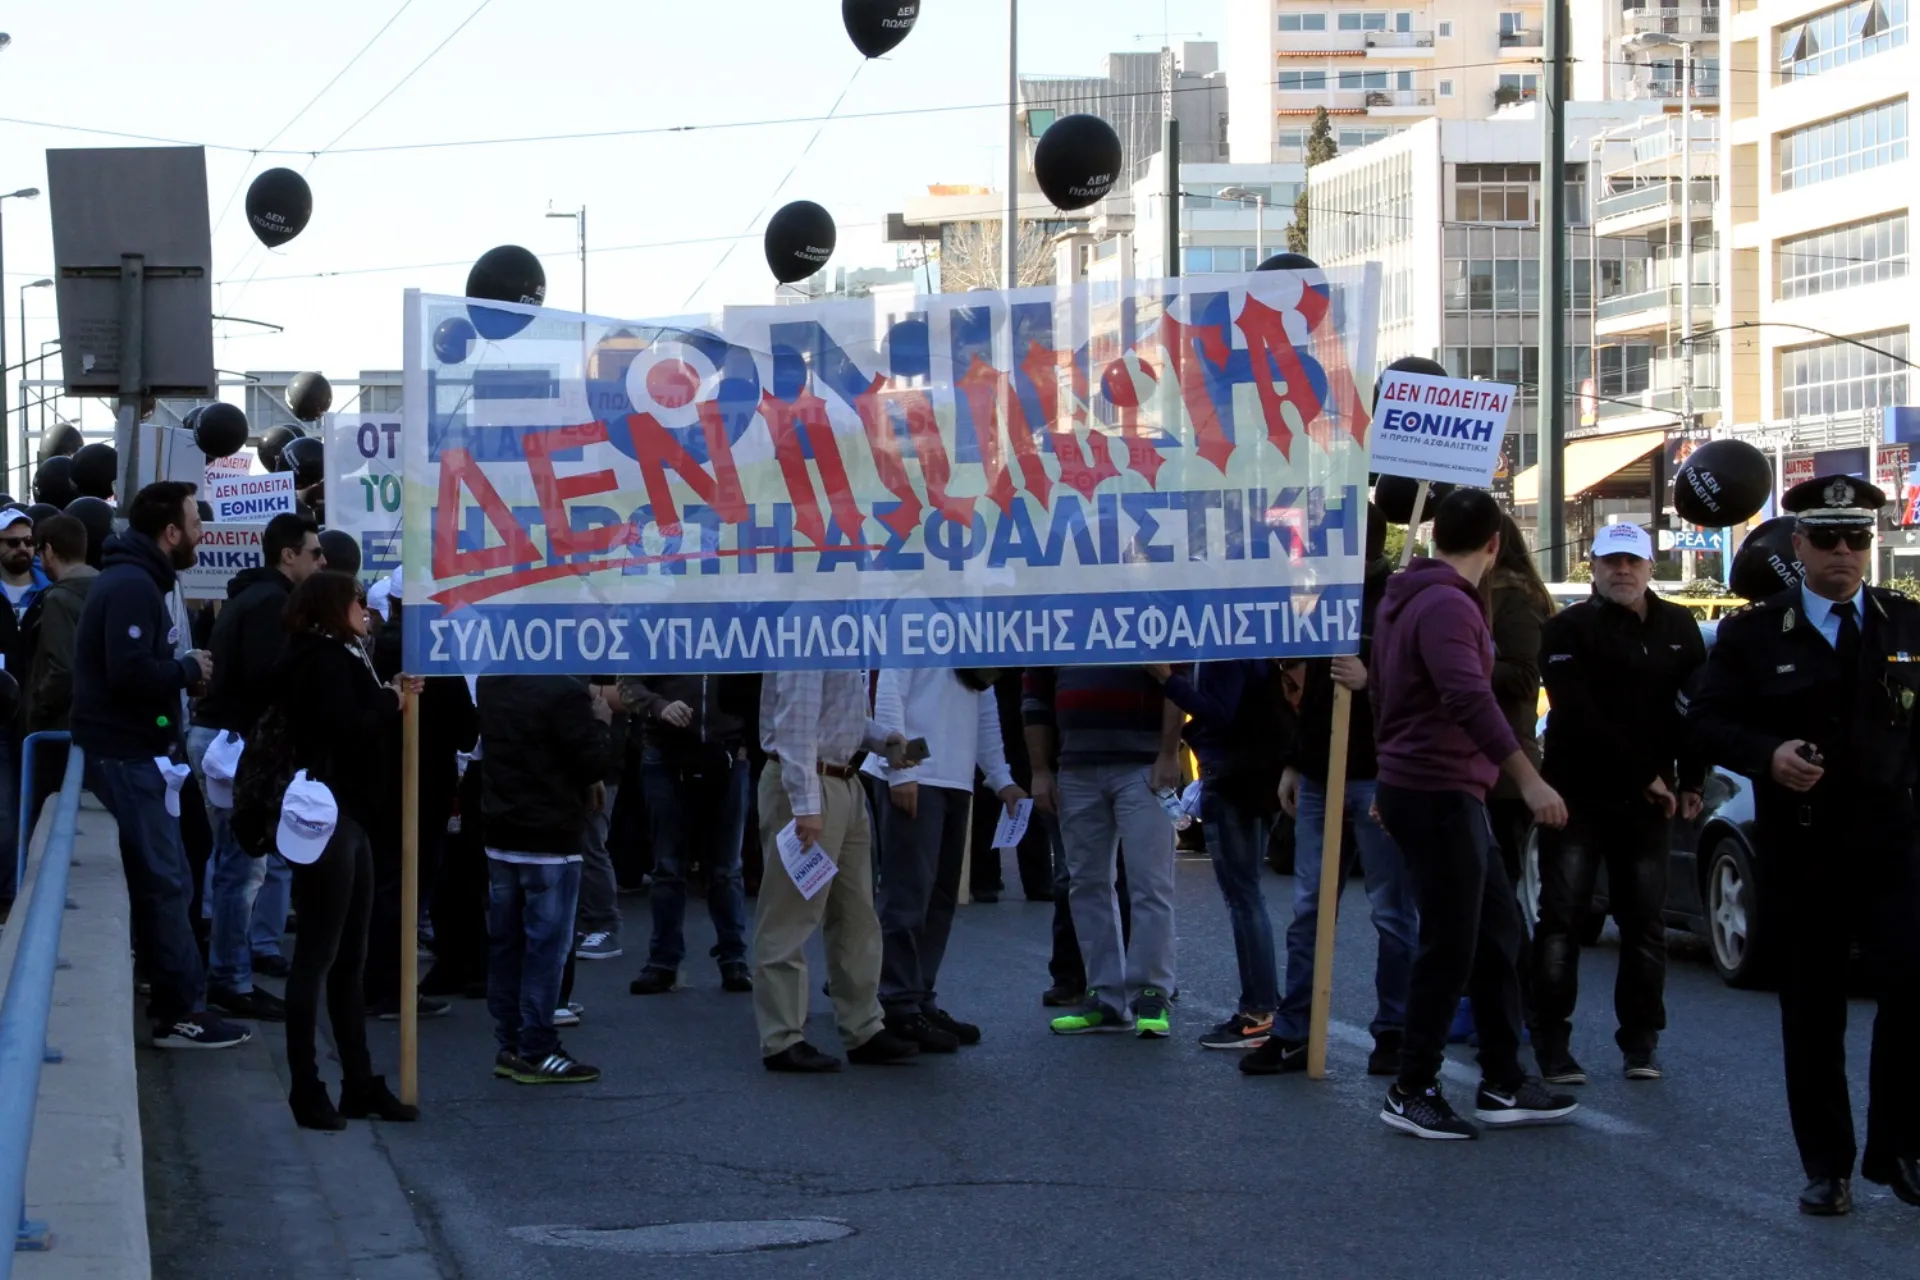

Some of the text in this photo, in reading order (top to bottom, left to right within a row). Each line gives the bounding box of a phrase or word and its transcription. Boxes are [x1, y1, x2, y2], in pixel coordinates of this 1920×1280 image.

[1087, 173, 1111, 186] ΔΕΝ
[265, 212, 286, 223] ΔΕΝ
[1384, 381, 1508, 413] ΔΕΝ ΠΩΛΕΙΤΑΙ
[1383, 408, 1494, 442] ΕΘΝΙΚΗ
[1389, 434, 1422, 445] ΠΡΩΤΗ
[1424, 437, 1489, 453] ΑΣΦΑΛΙΣΤΙΚΗ
[216, 485, 239, 499] ΔΕΝ
[241, 478, 292, 495] ΠΩΛΕΙΤΑΙ
[432, 399, 751, 581] ΔΕΝ
[1686, 466, 1721, 514] ΠΩΛΕΙΤΑΙ
[1700, 471, 1722, 495] ΔΕΝ
[220, 496, 289, 517] ΕΘΝΙΚΗ
[200, 531, 263, 546] ΩΛΕΙΤΑ
[511, 503, 794, 577] ΠΡΩΤΗ
[817, 484, 1359, 573] ΑΣΦΑΛΙΣΤΙΚΗ
[197, 551, 261, 569] ΝΙΚΗ
[1791, 561, 1806, 578] ΔΕ
[1768, 554, 1798, 589] ΠΩΛΕ
[429, 598, 1360, 662] ΣΥΛΛΟΓΟΣ ΥΠΑΛΛΗΛΩΝ ΕΘΝΙΚΗΣ ΑΣΦΑΛΙΣΤΙΚΗΣ
